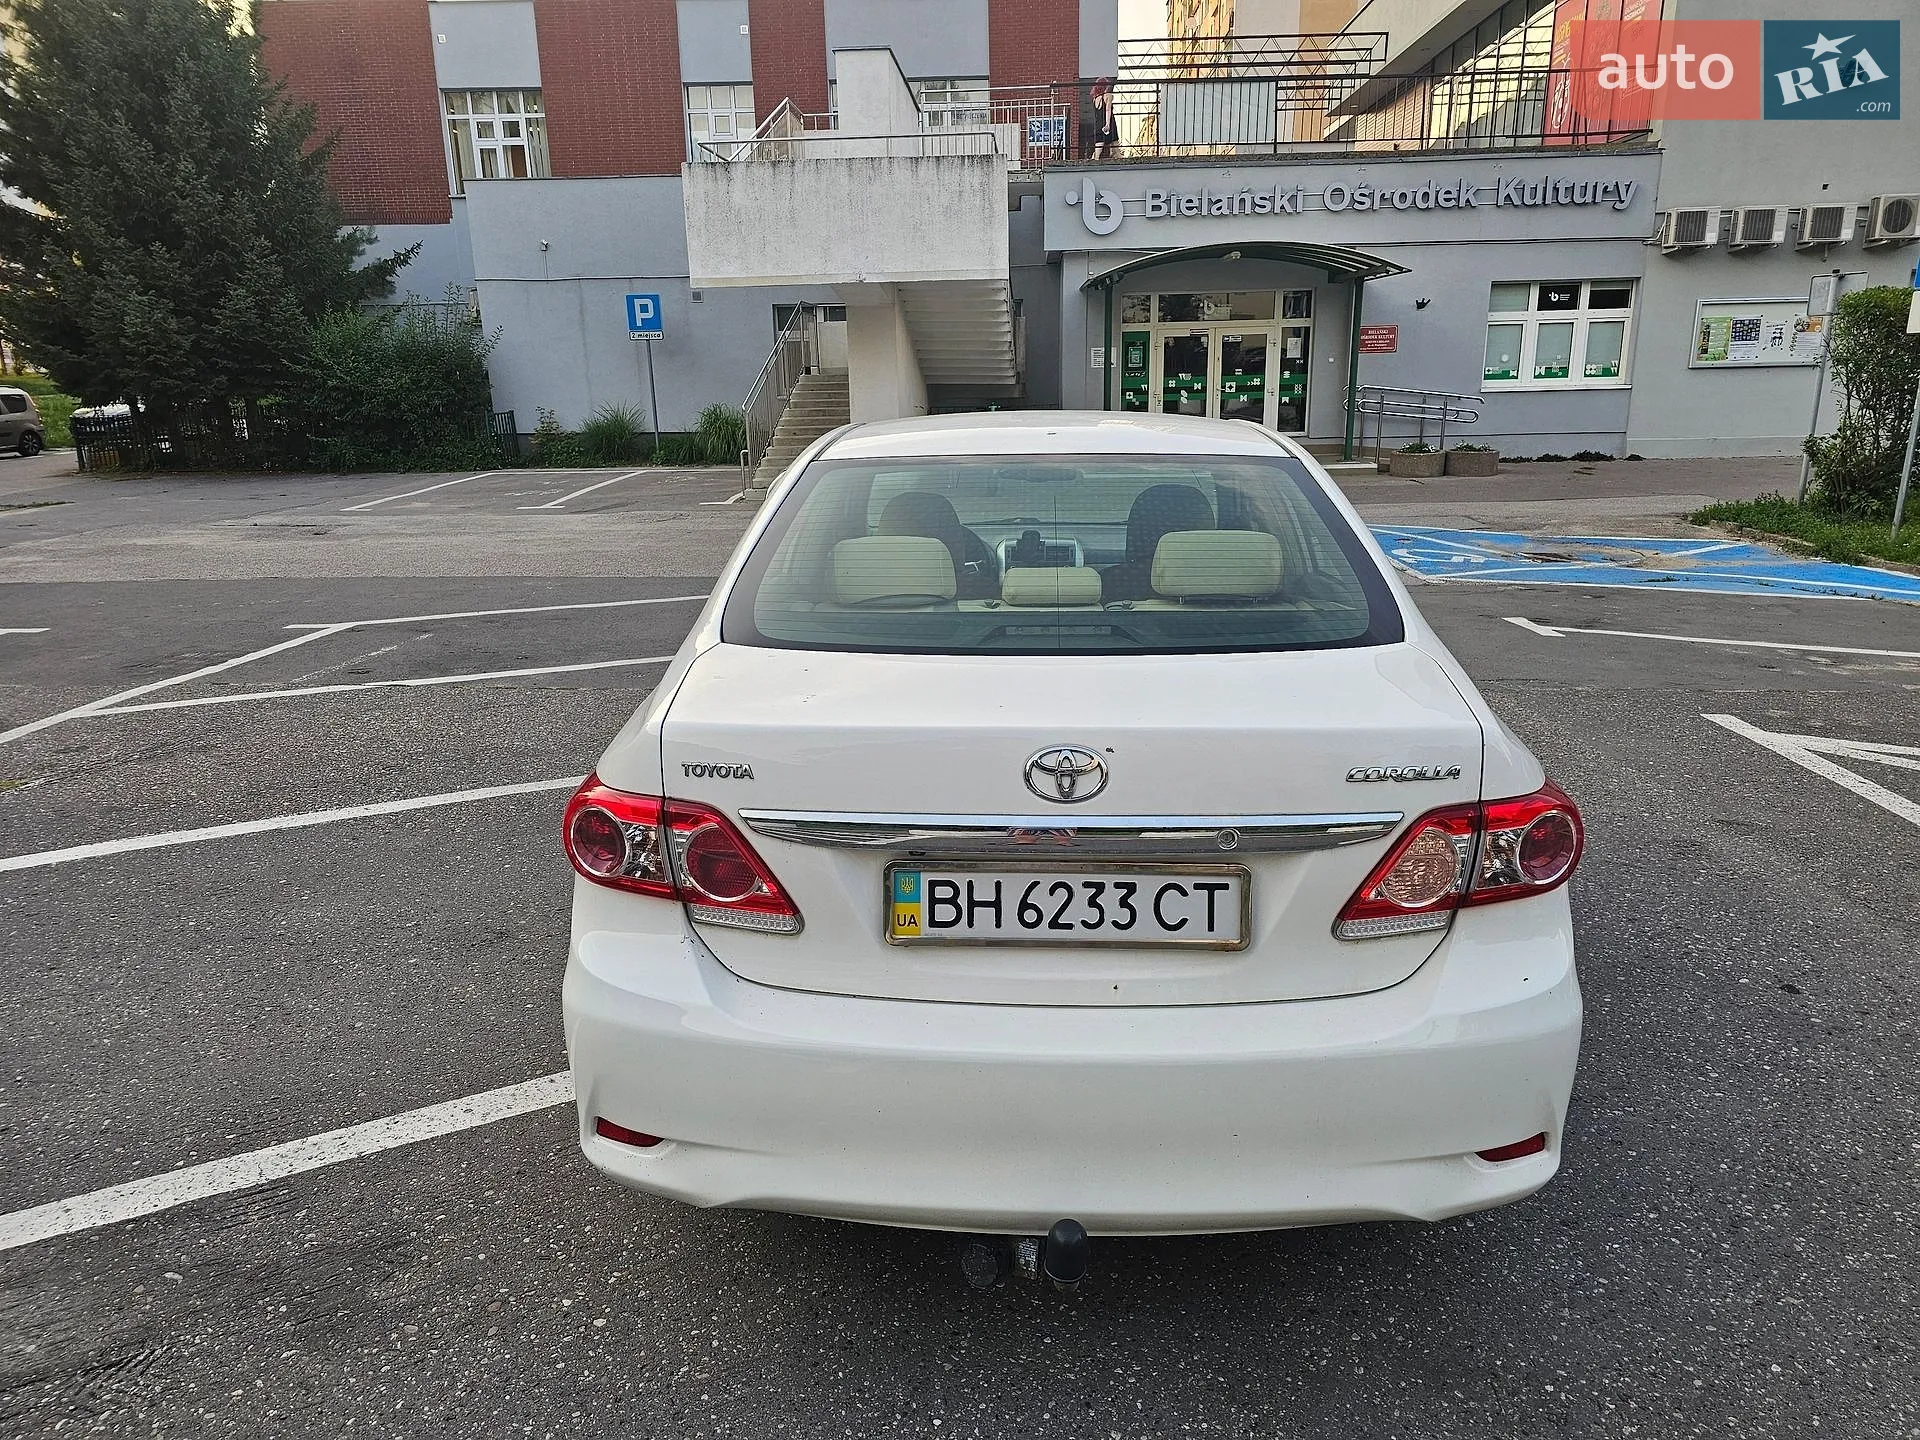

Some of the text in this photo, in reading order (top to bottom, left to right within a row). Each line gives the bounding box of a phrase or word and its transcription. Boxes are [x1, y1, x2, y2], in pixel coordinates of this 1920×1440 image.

[1145, 174, 1638, 218] Bielański Ośrodek Kultury
[634, 298, 654, 326] P
[682, 762, 754, 780] TOYOTA
[1346, 764, 1461, 783] COROLLA
[927, 879, 1231, 933] BH 6233 CT
[897, 914, 918, 928] UA
